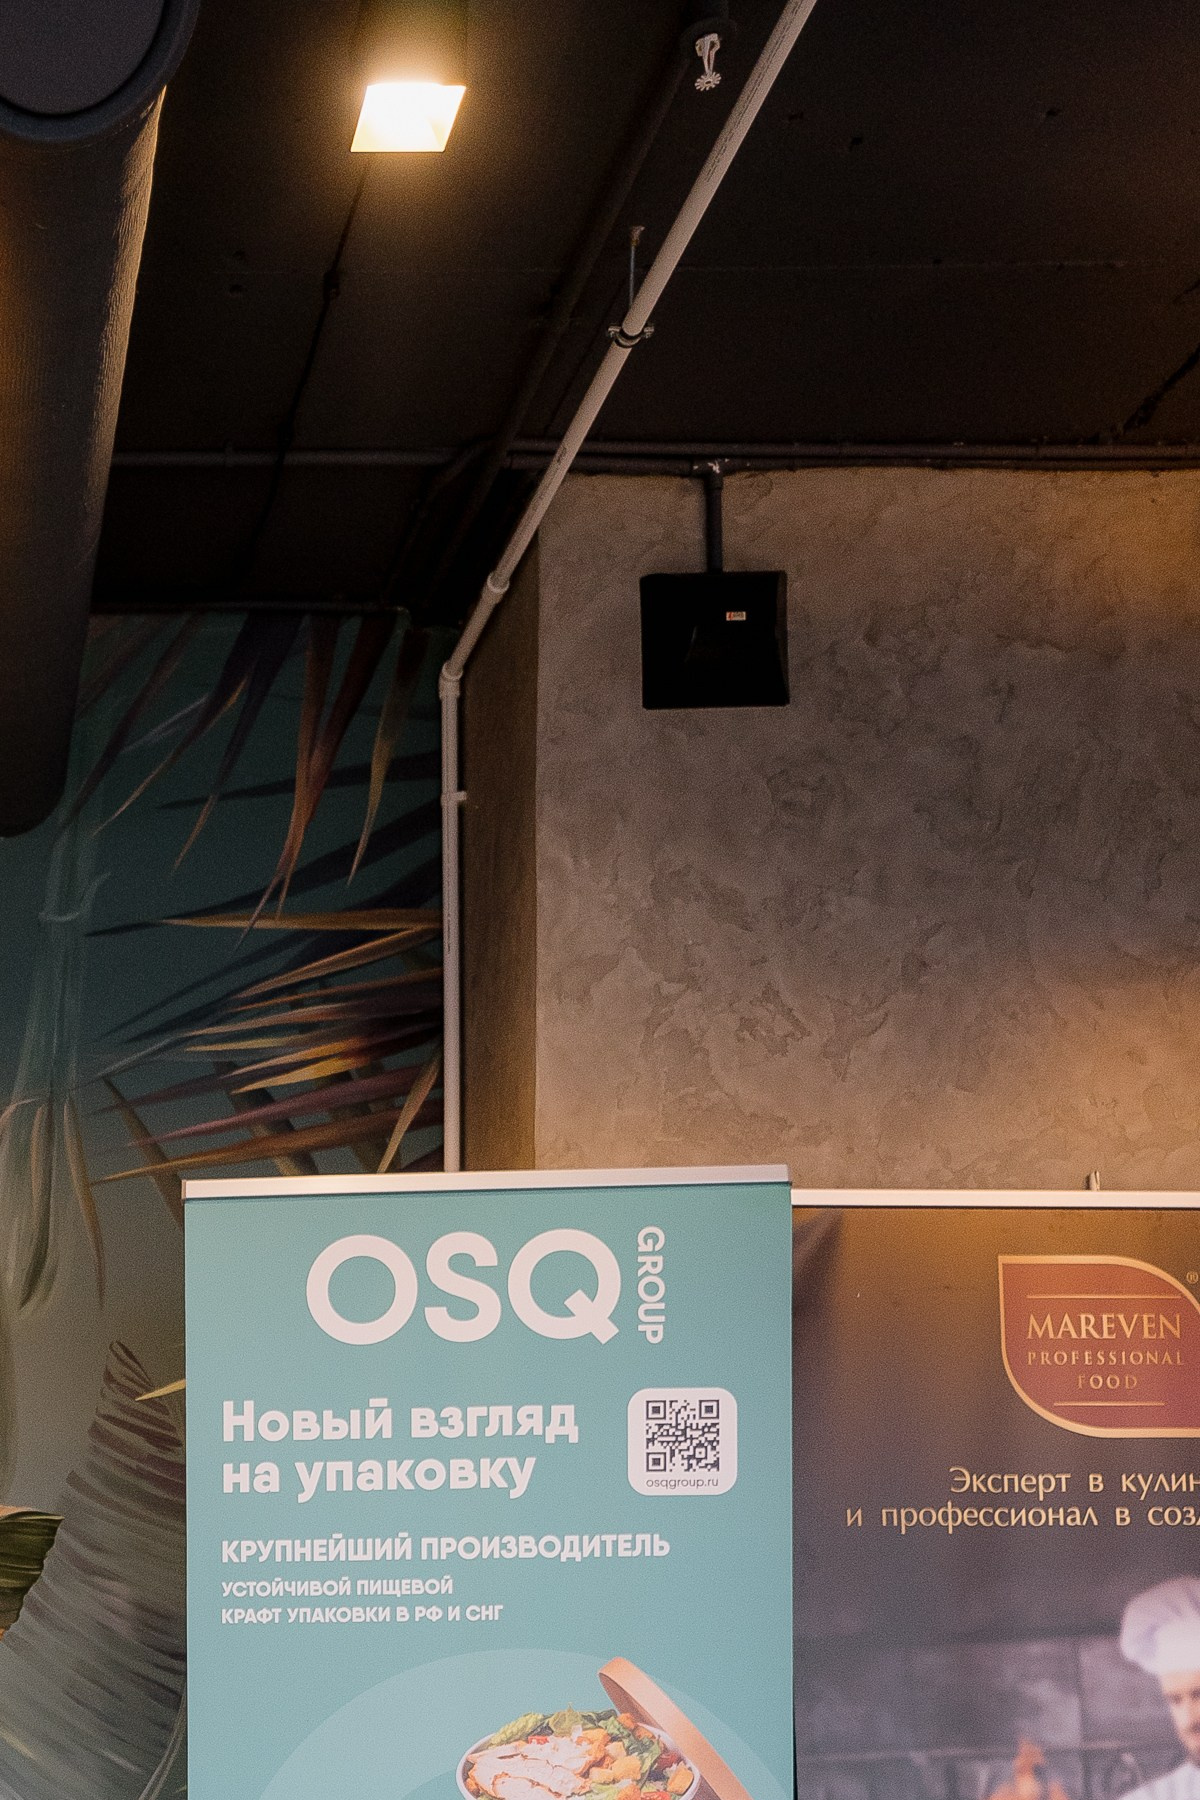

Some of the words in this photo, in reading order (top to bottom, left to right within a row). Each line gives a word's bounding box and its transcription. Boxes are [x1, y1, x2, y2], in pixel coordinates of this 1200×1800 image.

[306, 1228, 622, 1345] OSQ
[636, 1225, 665, 1344] GROUP
[1026, 1312, 1182, 1341] MAREVEN
[1027, 1350, 1185, 1367] PROFESSIONAL
[1077, 1373, 1138, 1391] FOOD
[222, 1397, 393, 1443] Новый
[410, 1403, 580, 1445] взгляд
[222, 1460, 281, 1495] на
[295, 1455, 538, 1504] упаковку
[645, 1478, 719, 1490] osqgroup.ru
[948, 1466, 1072, 1501] Эксперт
[1088, 1473, 1104, 1493] в
[846, 1509, 863, 1527] и
[881, 1501, 1099, 1535] профессионал
[1115, 1506, 1131, 1527] в
[221, 1533, 414, 1564] КРУПНЕЙШИЙ
[421, 1533, 671, 1563] ПРОИЗВОДИТЕЛЬ
[221, 1576, 352, 1598] УСТОЙЧИВОЙ
[356, 1575, 454, 1598] ПИЩЕВОЙ
[221, 1607, 283, 1625] КРАФТ
[286, 1605, 392, 1624] УПАКОВКИ
[396, 1606, 410, 1622] В
[414, 1605, 443, 1623] РФ
[447, 1605, 461, 1622] И
[464, 1604, 504, 1622] СНГ
